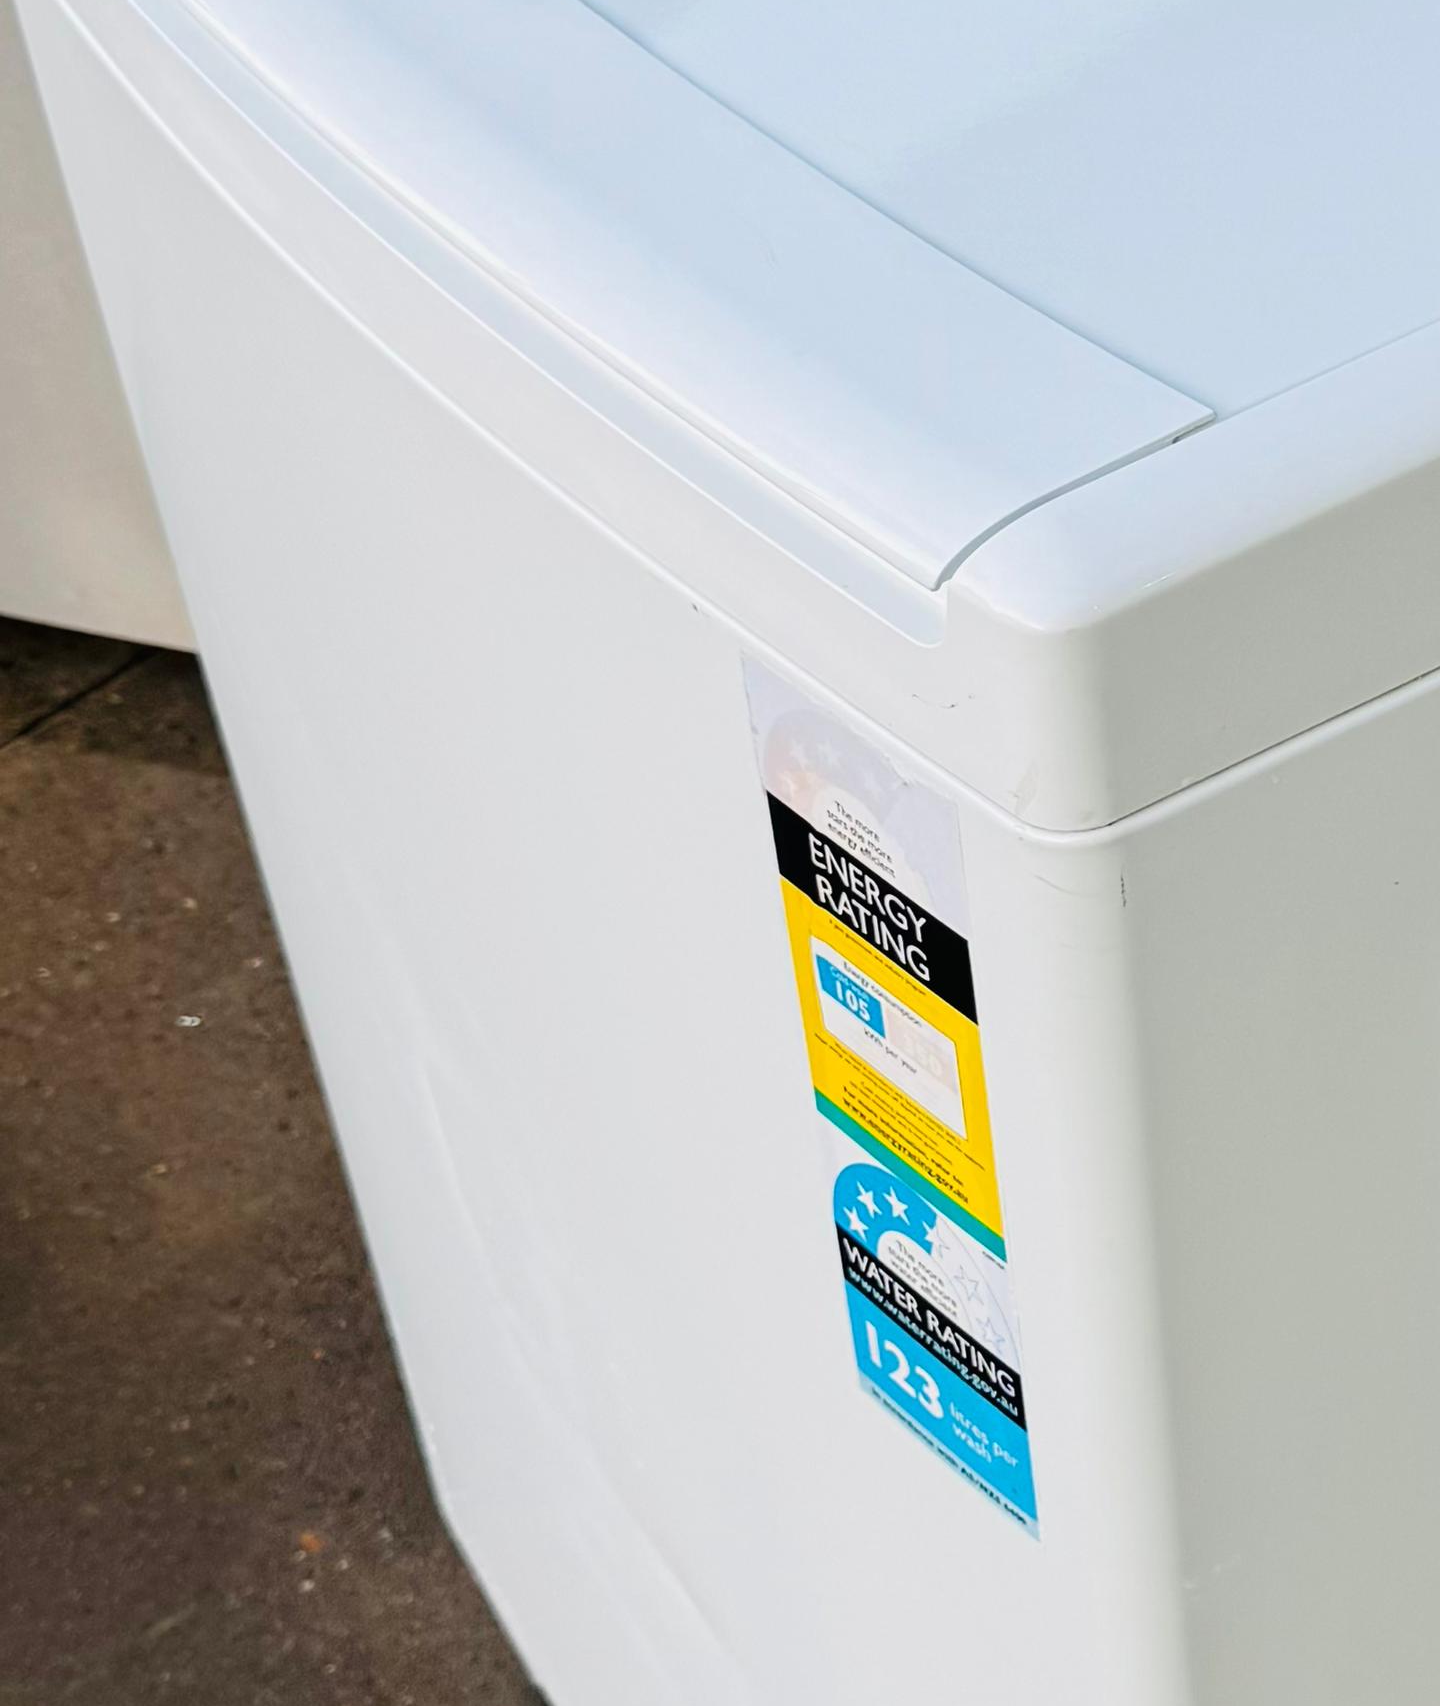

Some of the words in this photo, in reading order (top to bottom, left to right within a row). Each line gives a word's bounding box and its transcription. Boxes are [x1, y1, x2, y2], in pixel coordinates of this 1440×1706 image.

[826, 807, 848, 831] stars
[849, 824, 864, 843] the
[867, 839, 892, 864] more
[827, 820, 858, 853] energy
[859, 843, 895, 878] efficient
[835, 800, 852, 822] The
[855, 817, 879, 843] more
[808, 833, 927, 942] ENERGY
[815, 874, 930, 981] RATING
[835, 981, 871, 1021] 105
[842, 959, 869, 990] Energy
[870, 983, 921, 1030] consumption
[918, 1259, 944, 1287] more
[844, 1238, 921, 1321] WATER
[926, 1310, 1016, 1397] RATING
[849, 1267, 1018, 1417] www.waterrating.gov.au
[866, 1320, 944, 1419] 123
[950, 1402, 989, 1445] litres
[993, 1442, 1018, 1468] per
[952, 1424, 991, 1463] wash
